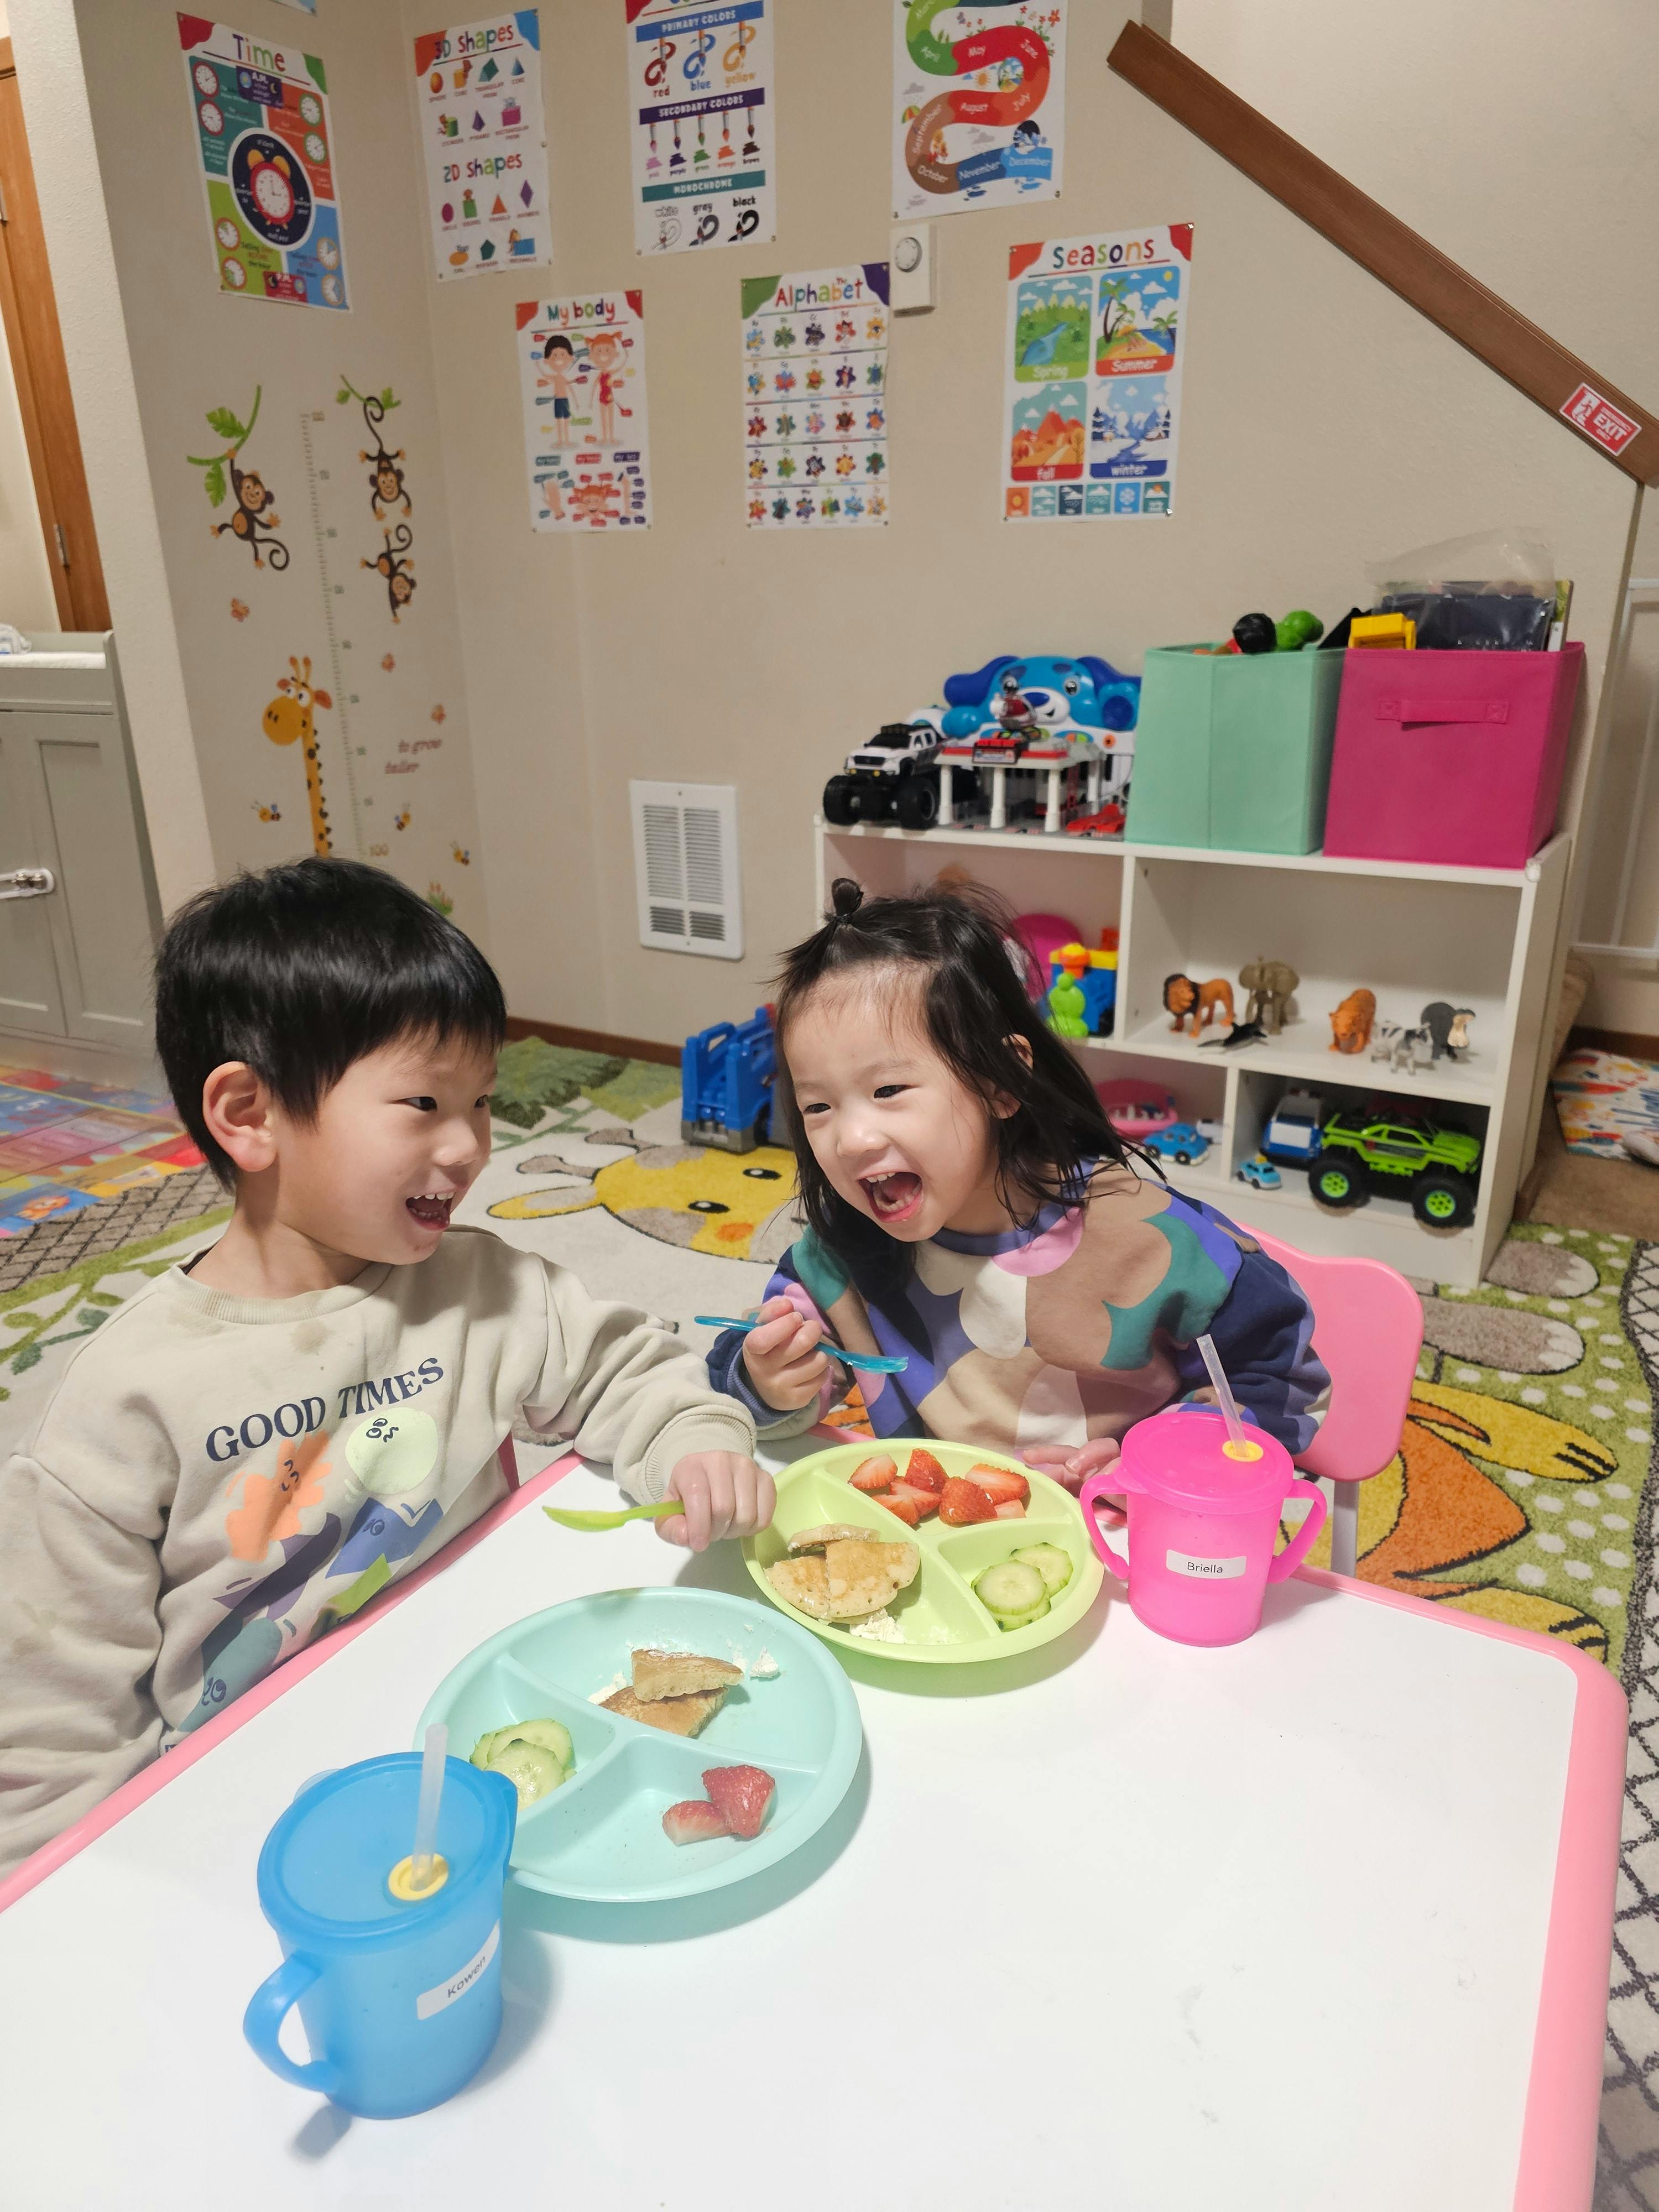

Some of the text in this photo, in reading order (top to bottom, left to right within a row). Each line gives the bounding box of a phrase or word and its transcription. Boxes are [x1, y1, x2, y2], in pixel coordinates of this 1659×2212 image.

[701, 10, 736, 25] COLORS
[232, 33, 286, 72] Time
[434, 25, 514, 60] 3D shapes
[653, 86, 670, 98] red
[690, 80, 711, 92] blue
[444, 153, 523, 183] 2D shapes
[733, 196, 757, 208] black
[775, 277, 864, 313] Alphabet
[547, 298, 615, 327] My body
[1593, 411, 1628, 441] EXIT
[205, 1357, 444, 1462] GOOD TIMES
[1187, 1562, 1223, 1573] Briella
[447, 1956, 486, 1999] Kowen
